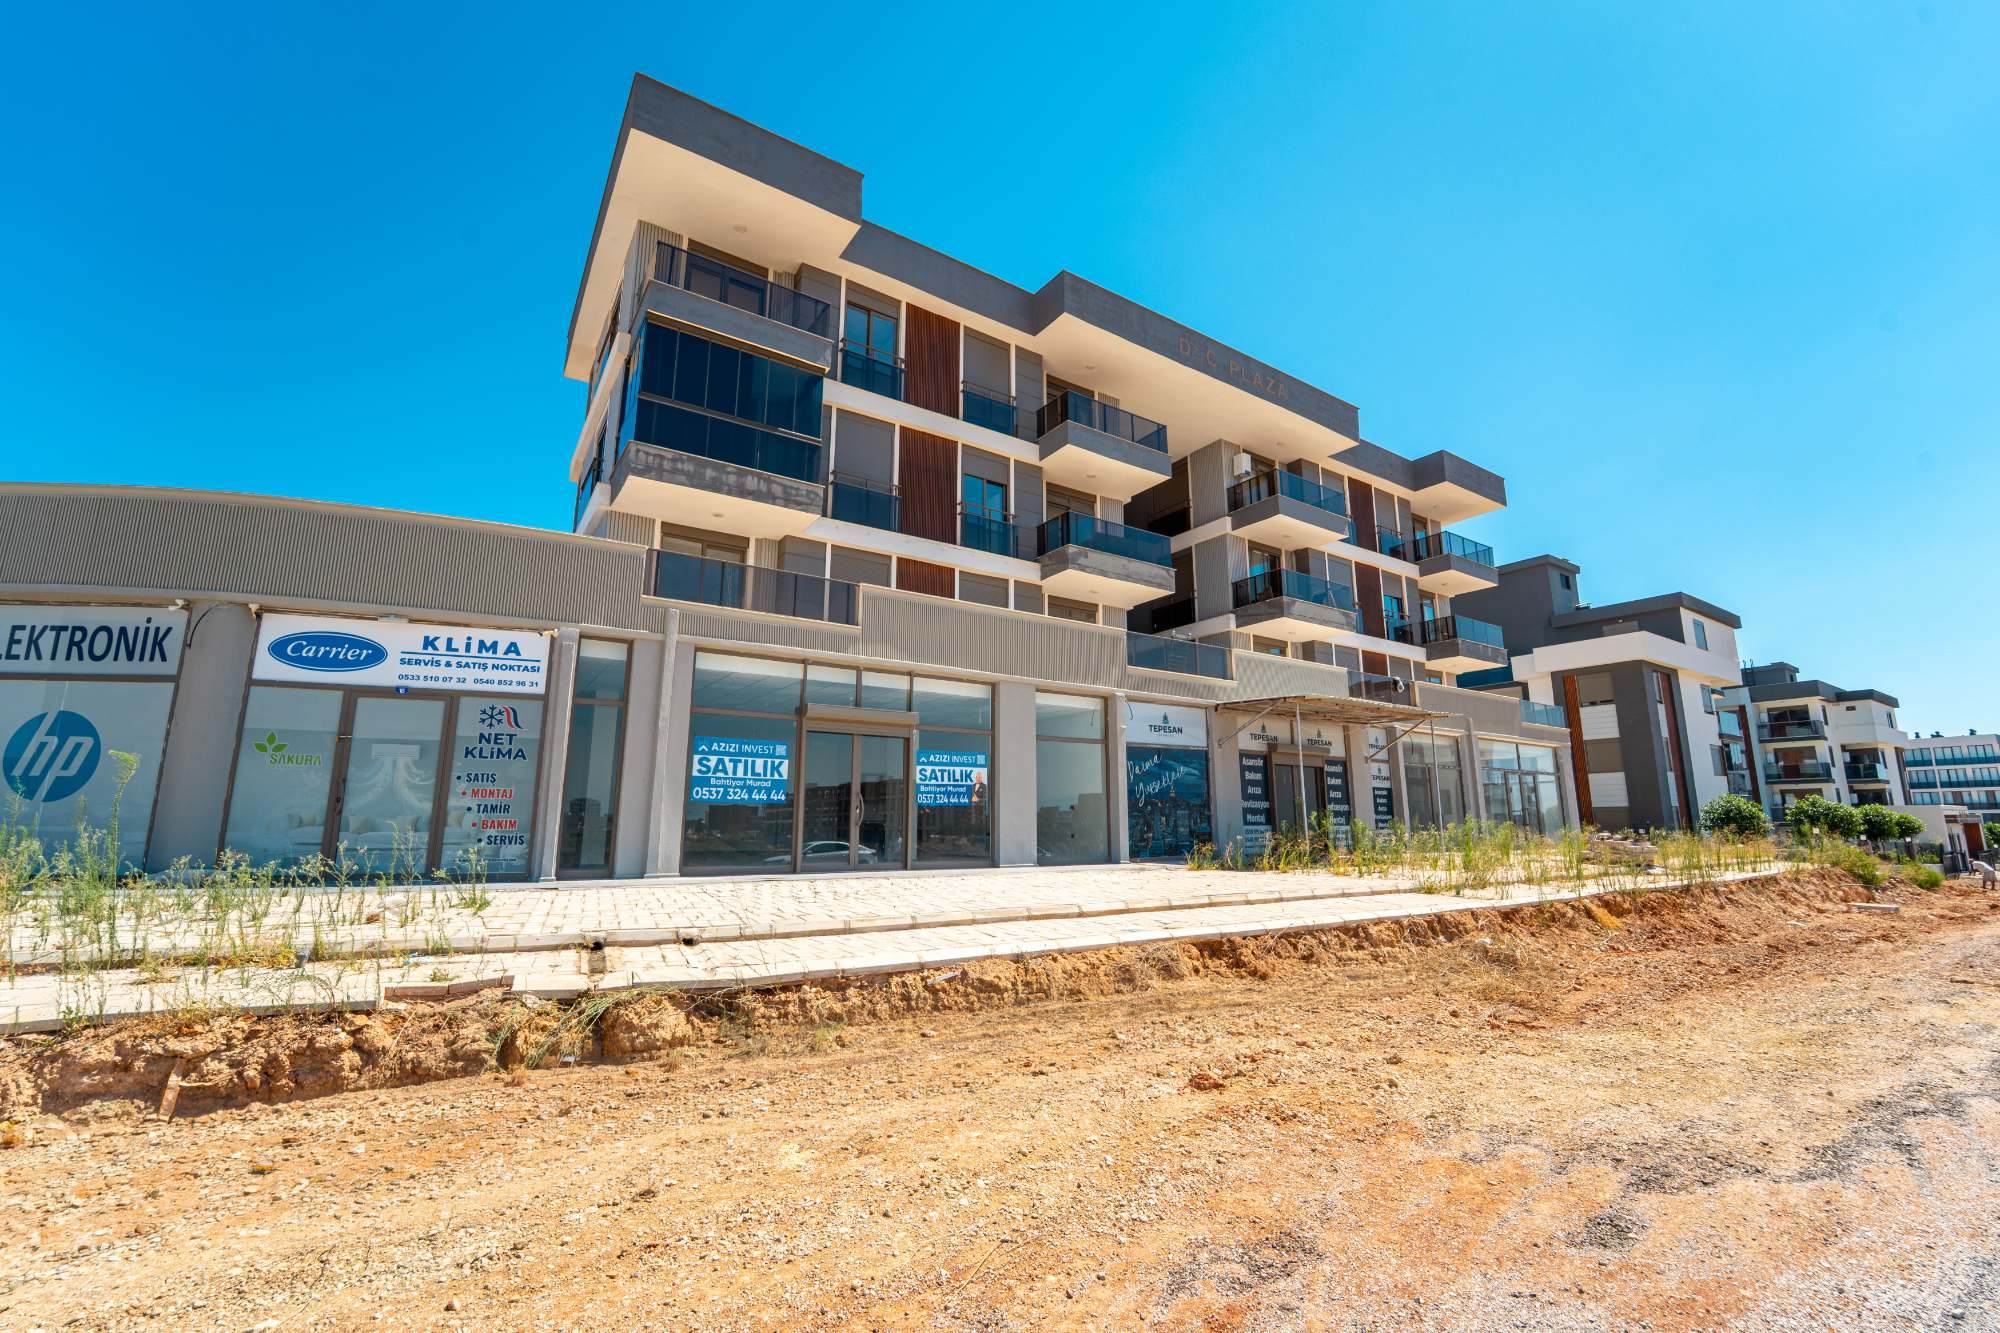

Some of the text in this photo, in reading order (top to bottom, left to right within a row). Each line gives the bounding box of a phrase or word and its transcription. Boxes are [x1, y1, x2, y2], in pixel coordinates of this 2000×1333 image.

[1229, 360, 1289, 400] PLAZA
[0, 617, 173, 662] EKTRONİK
[286, 640, 372, 661] Carrier
[400, 657, 540, 673] SERVİS & SATIŞ NOKTASI
[1148, 724, 1183, 735] TEPESAN
[478, 732, 517, 745] NET
[1250, 733, 1278, 742] TEPESAN
[1306, 738, 1332, 747] TEPESAN
[711, 743, 773, 754] AZIZI INVEST
[11, 711, 94, 801] hp
[270, 753, 321, 765] SAKURA
[929, 754, 976, 764] AZIZI INVEST
[697, 756, 784, 778] SATILIK
[466, 773, 497, 786] SATIŞ
[919, 767, 974, 783] SATILIK
[710, 778, 771, 787] Bahtiyar Murad
[471, 788, 513, 799] MONTAJ
[693, 787, 786, 800] 0537 324 44 44
[920, 785, 946, 793] Bahtiyar
[918, 794, 968, 804] 0537 324 44 44
[476, 802, 510, 814] TAMİR
[481, 819, 518, 830] BAKIM
[486, 833, 525, 846] SERVİS
